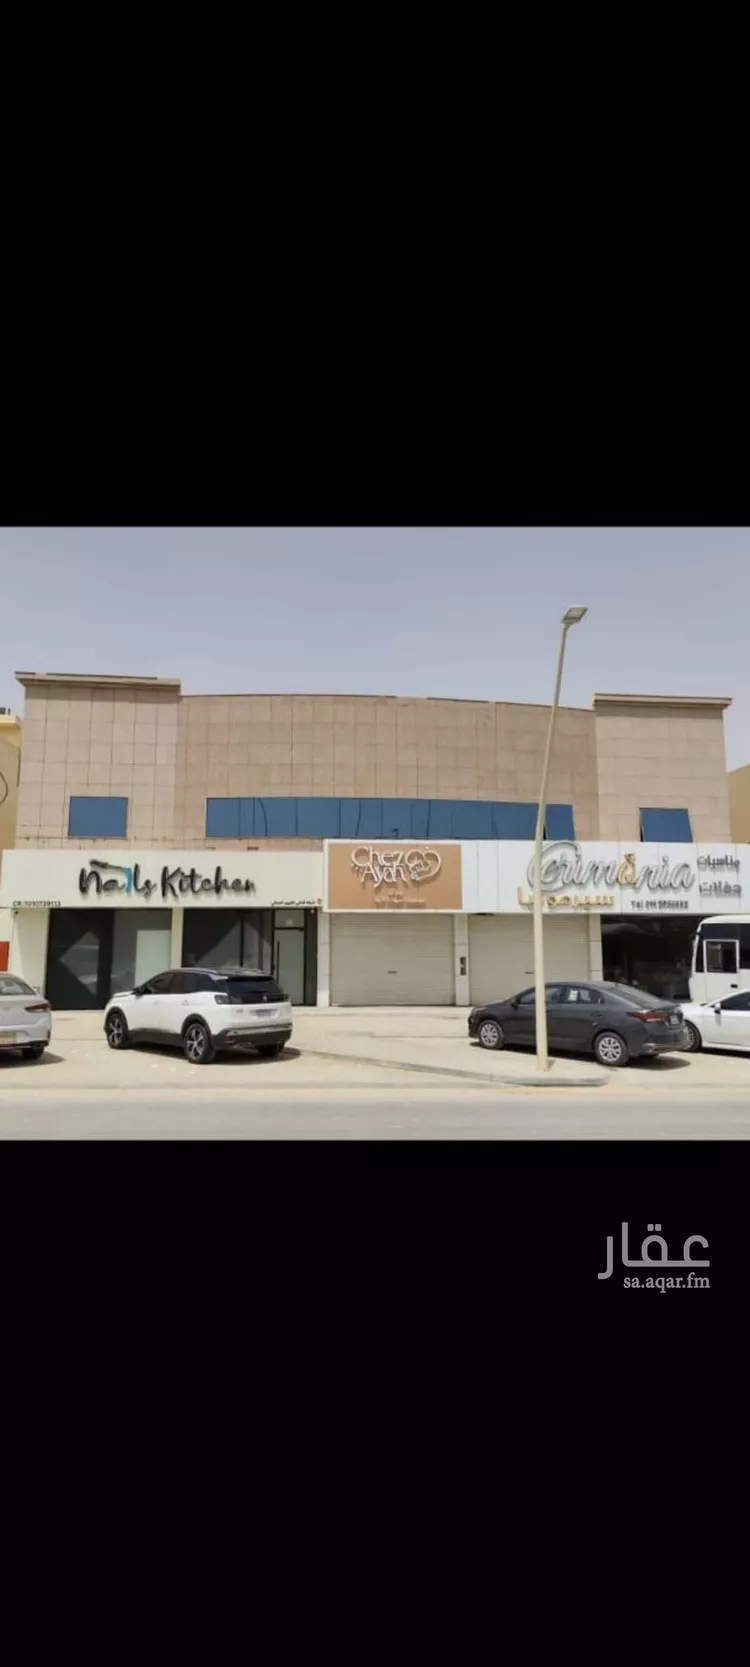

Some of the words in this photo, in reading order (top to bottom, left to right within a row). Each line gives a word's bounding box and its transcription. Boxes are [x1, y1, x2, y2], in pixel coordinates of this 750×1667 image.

[351, 846, 404, 867] Chez
[696, 855, 740, 871] مناسبات
[161, 865, 256, 899] Kitchen
[361, 861, 408, 888] Ayah
[698, 881, 742, 897] حفلات
